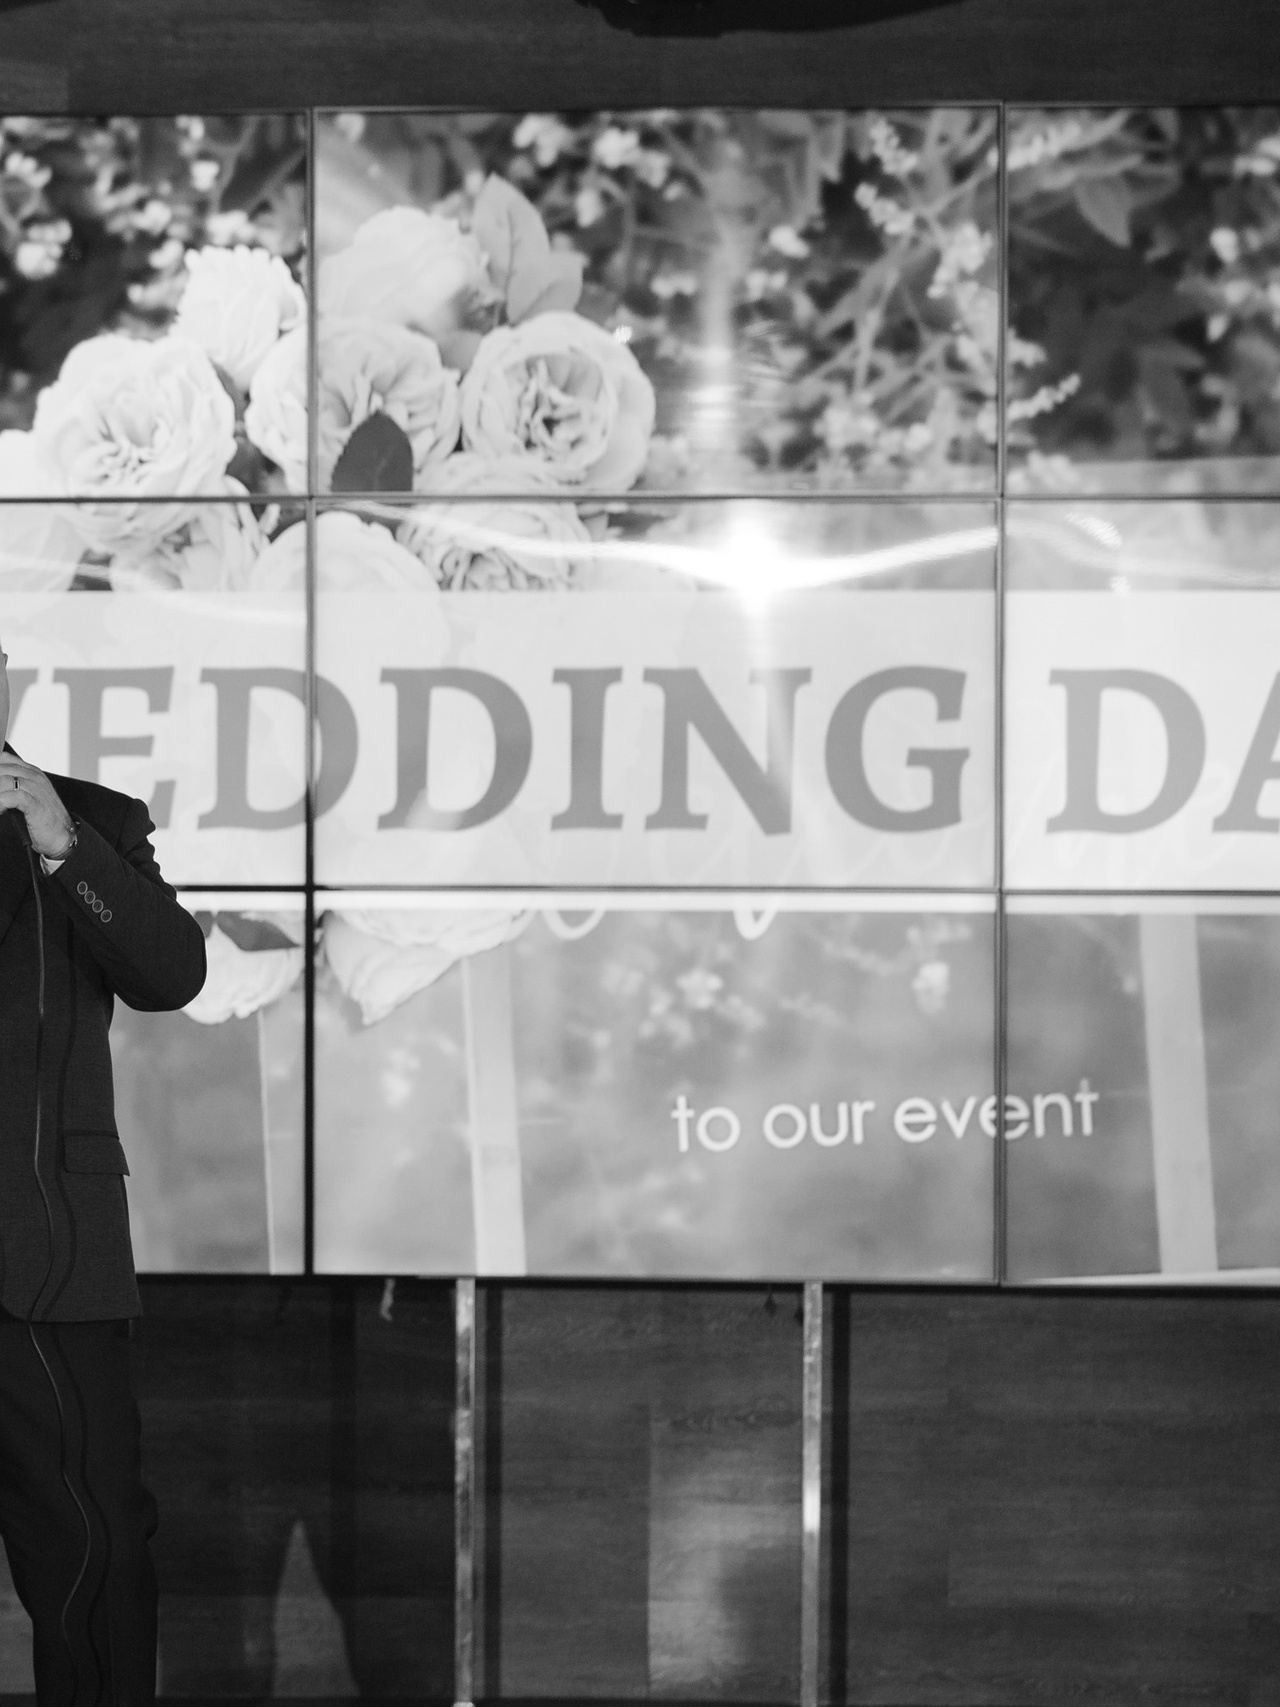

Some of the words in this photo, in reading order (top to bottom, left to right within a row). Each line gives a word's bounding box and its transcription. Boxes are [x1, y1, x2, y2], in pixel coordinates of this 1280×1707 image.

[670, 1094, 741, 1152] to
[762, 1099, 876, 1149] our
[893, 1078, 1100, 1143] event
